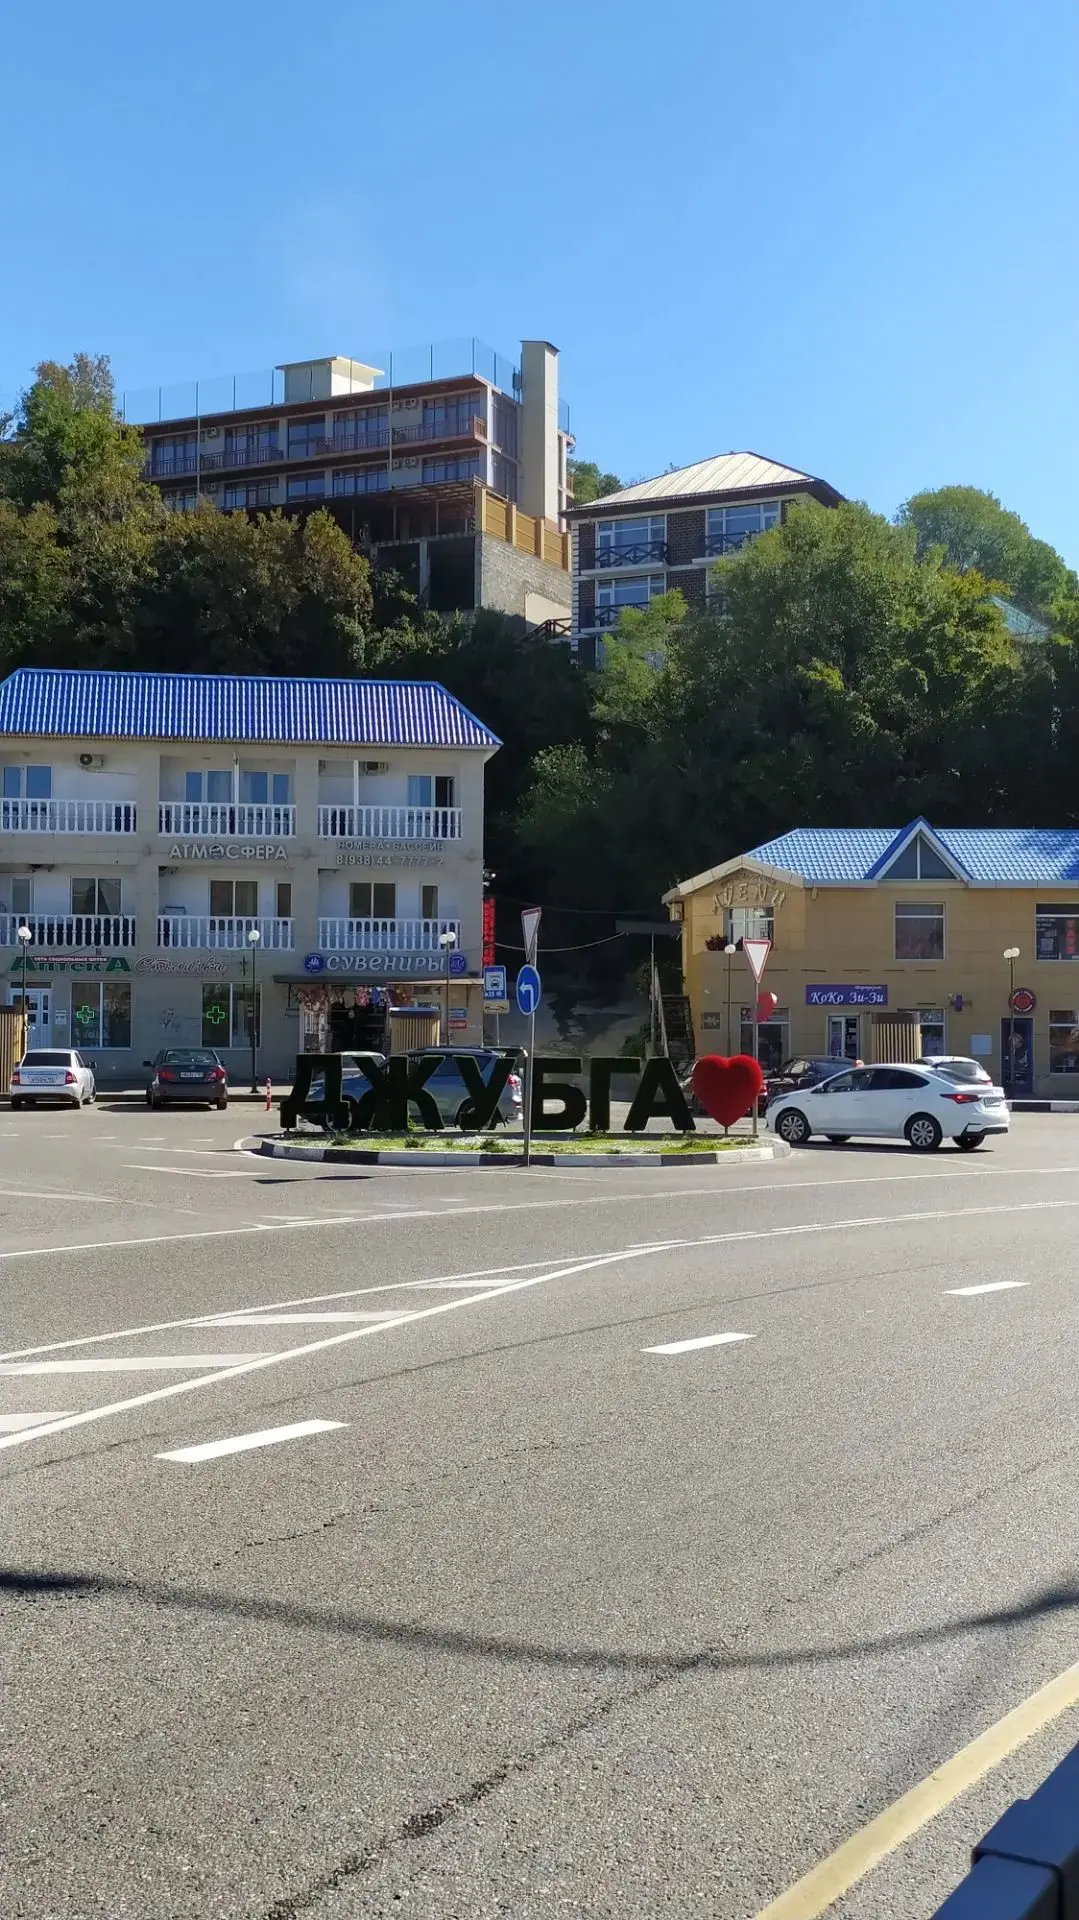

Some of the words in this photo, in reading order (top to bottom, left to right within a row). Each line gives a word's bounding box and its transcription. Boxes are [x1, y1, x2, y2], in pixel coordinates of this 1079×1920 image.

[169, 844, 288, 860] АТМОСФЕРА
[337, 841, 385, 850] НОМЕРА
[279, 1054, 697, 1131] ДЖУБГА
